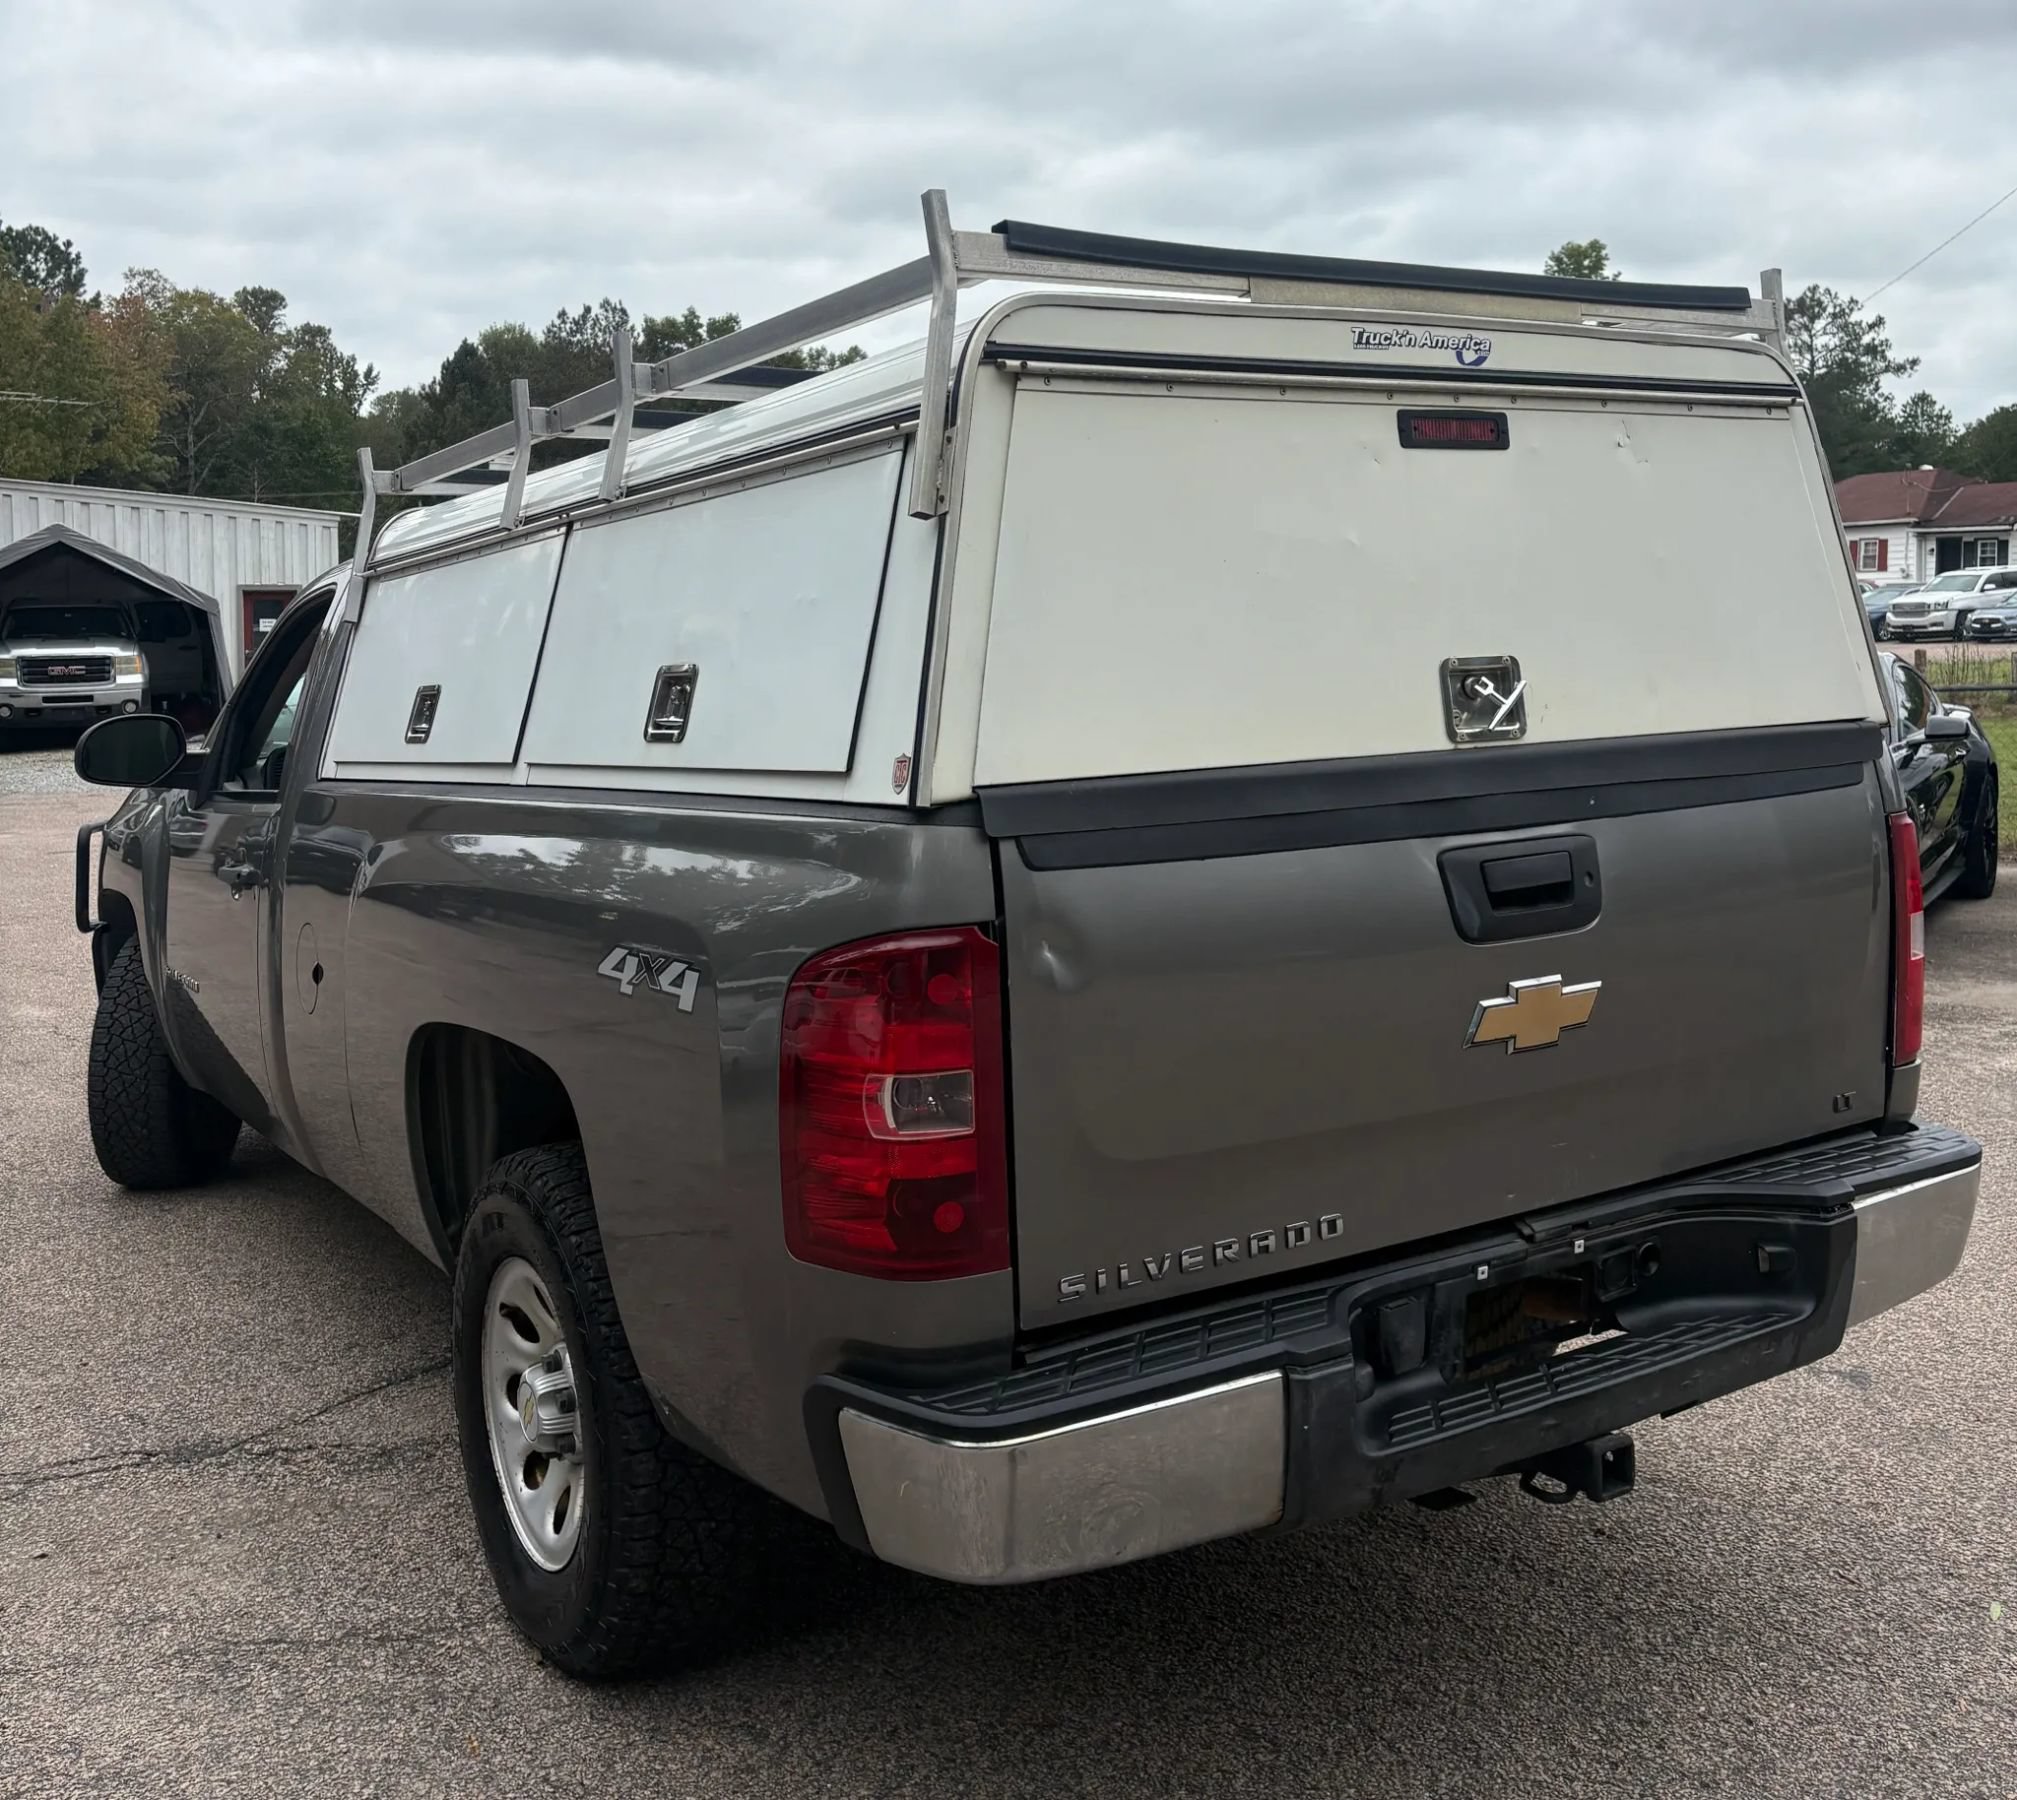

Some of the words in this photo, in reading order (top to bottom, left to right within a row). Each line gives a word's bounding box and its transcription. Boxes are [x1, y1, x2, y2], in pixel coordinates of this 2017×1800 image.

[1351, 327, 1417, 348] Truck'n
[1419, 331, 1491, 351] America
[48, 665, 86, 676] GMC
[1058, 1213, 1344, 1302] SILVERADO
